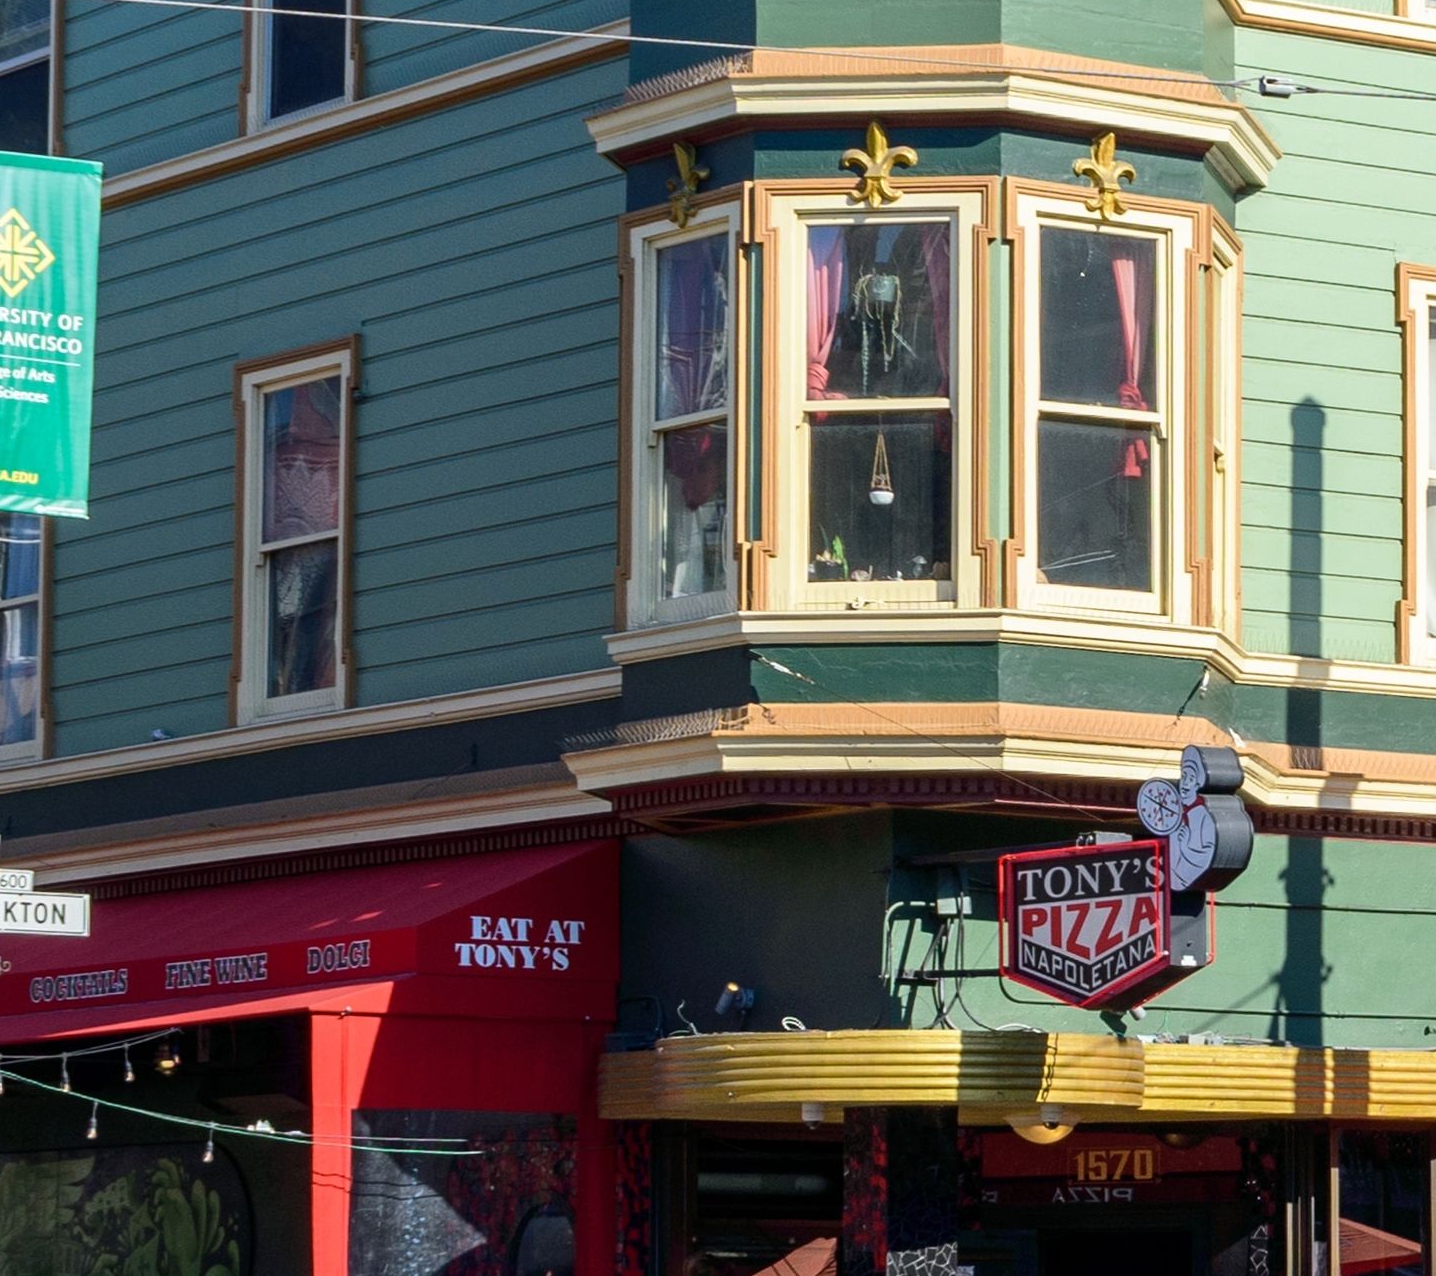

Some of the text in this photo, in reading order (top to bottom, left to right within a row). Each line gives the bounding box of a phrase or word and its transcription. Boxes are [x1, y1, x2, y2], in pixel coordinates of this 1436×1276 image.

[58, 315, 84, 332] OF
[13, 367, 27, 379] of
[28, 369, 56, 383] Arts
[1017, 856, 1164, 901] TONY'S
[470, 915, 585, 945] EAT AT
[1022, 896, 1158, 960] PIZZA
[30, 969, 127, 1004] COCKTAILS
[166, 958, 211, 990] FINE
[215, 953, 267, 985] WINE
[307, 940, 370, 974] DOLCI
[455, 943, 570, 971] TONY'S
[1023, 933, 1156, 989] NAPOLETANA
[1074, 1149, 1153, 1181] 1570
